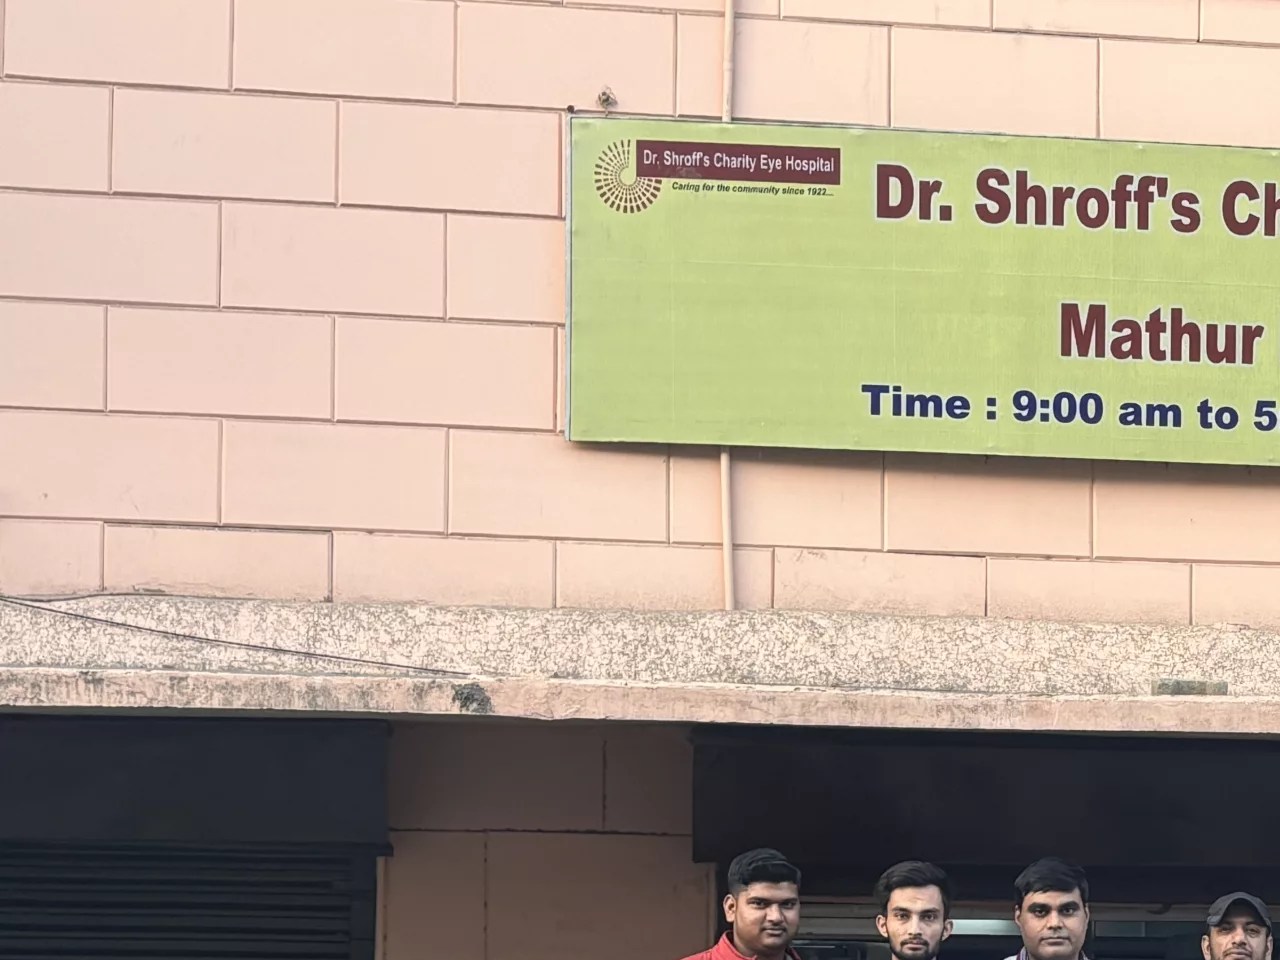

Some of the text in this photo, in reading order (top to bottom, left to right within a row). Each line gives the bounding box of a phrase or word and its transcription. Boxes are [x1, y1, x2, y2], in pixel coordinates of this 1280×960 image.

[644, 150, 834, 174] Dr. Shroff's Charity Eye Hospital
[672, 182, 700, 192] Caring
[702, 183, 714, 191] for
[717, 184, 730, 192] the
[732, 186, 780, 195] community
[782, 187, 804, 195] since
[877, 164, 952, 221] Dr.
[975, 169, 1200, 233] Shroff's
[1061, 303, 1264, 364] Mathur
[862, 385, 970, 419] Time
[987, 398, 996, 420] :
[1013, 390, 1103, 424] 9:00
[1119, 403, 1181, 427] am
[1197, 400, 1238, 429] to
